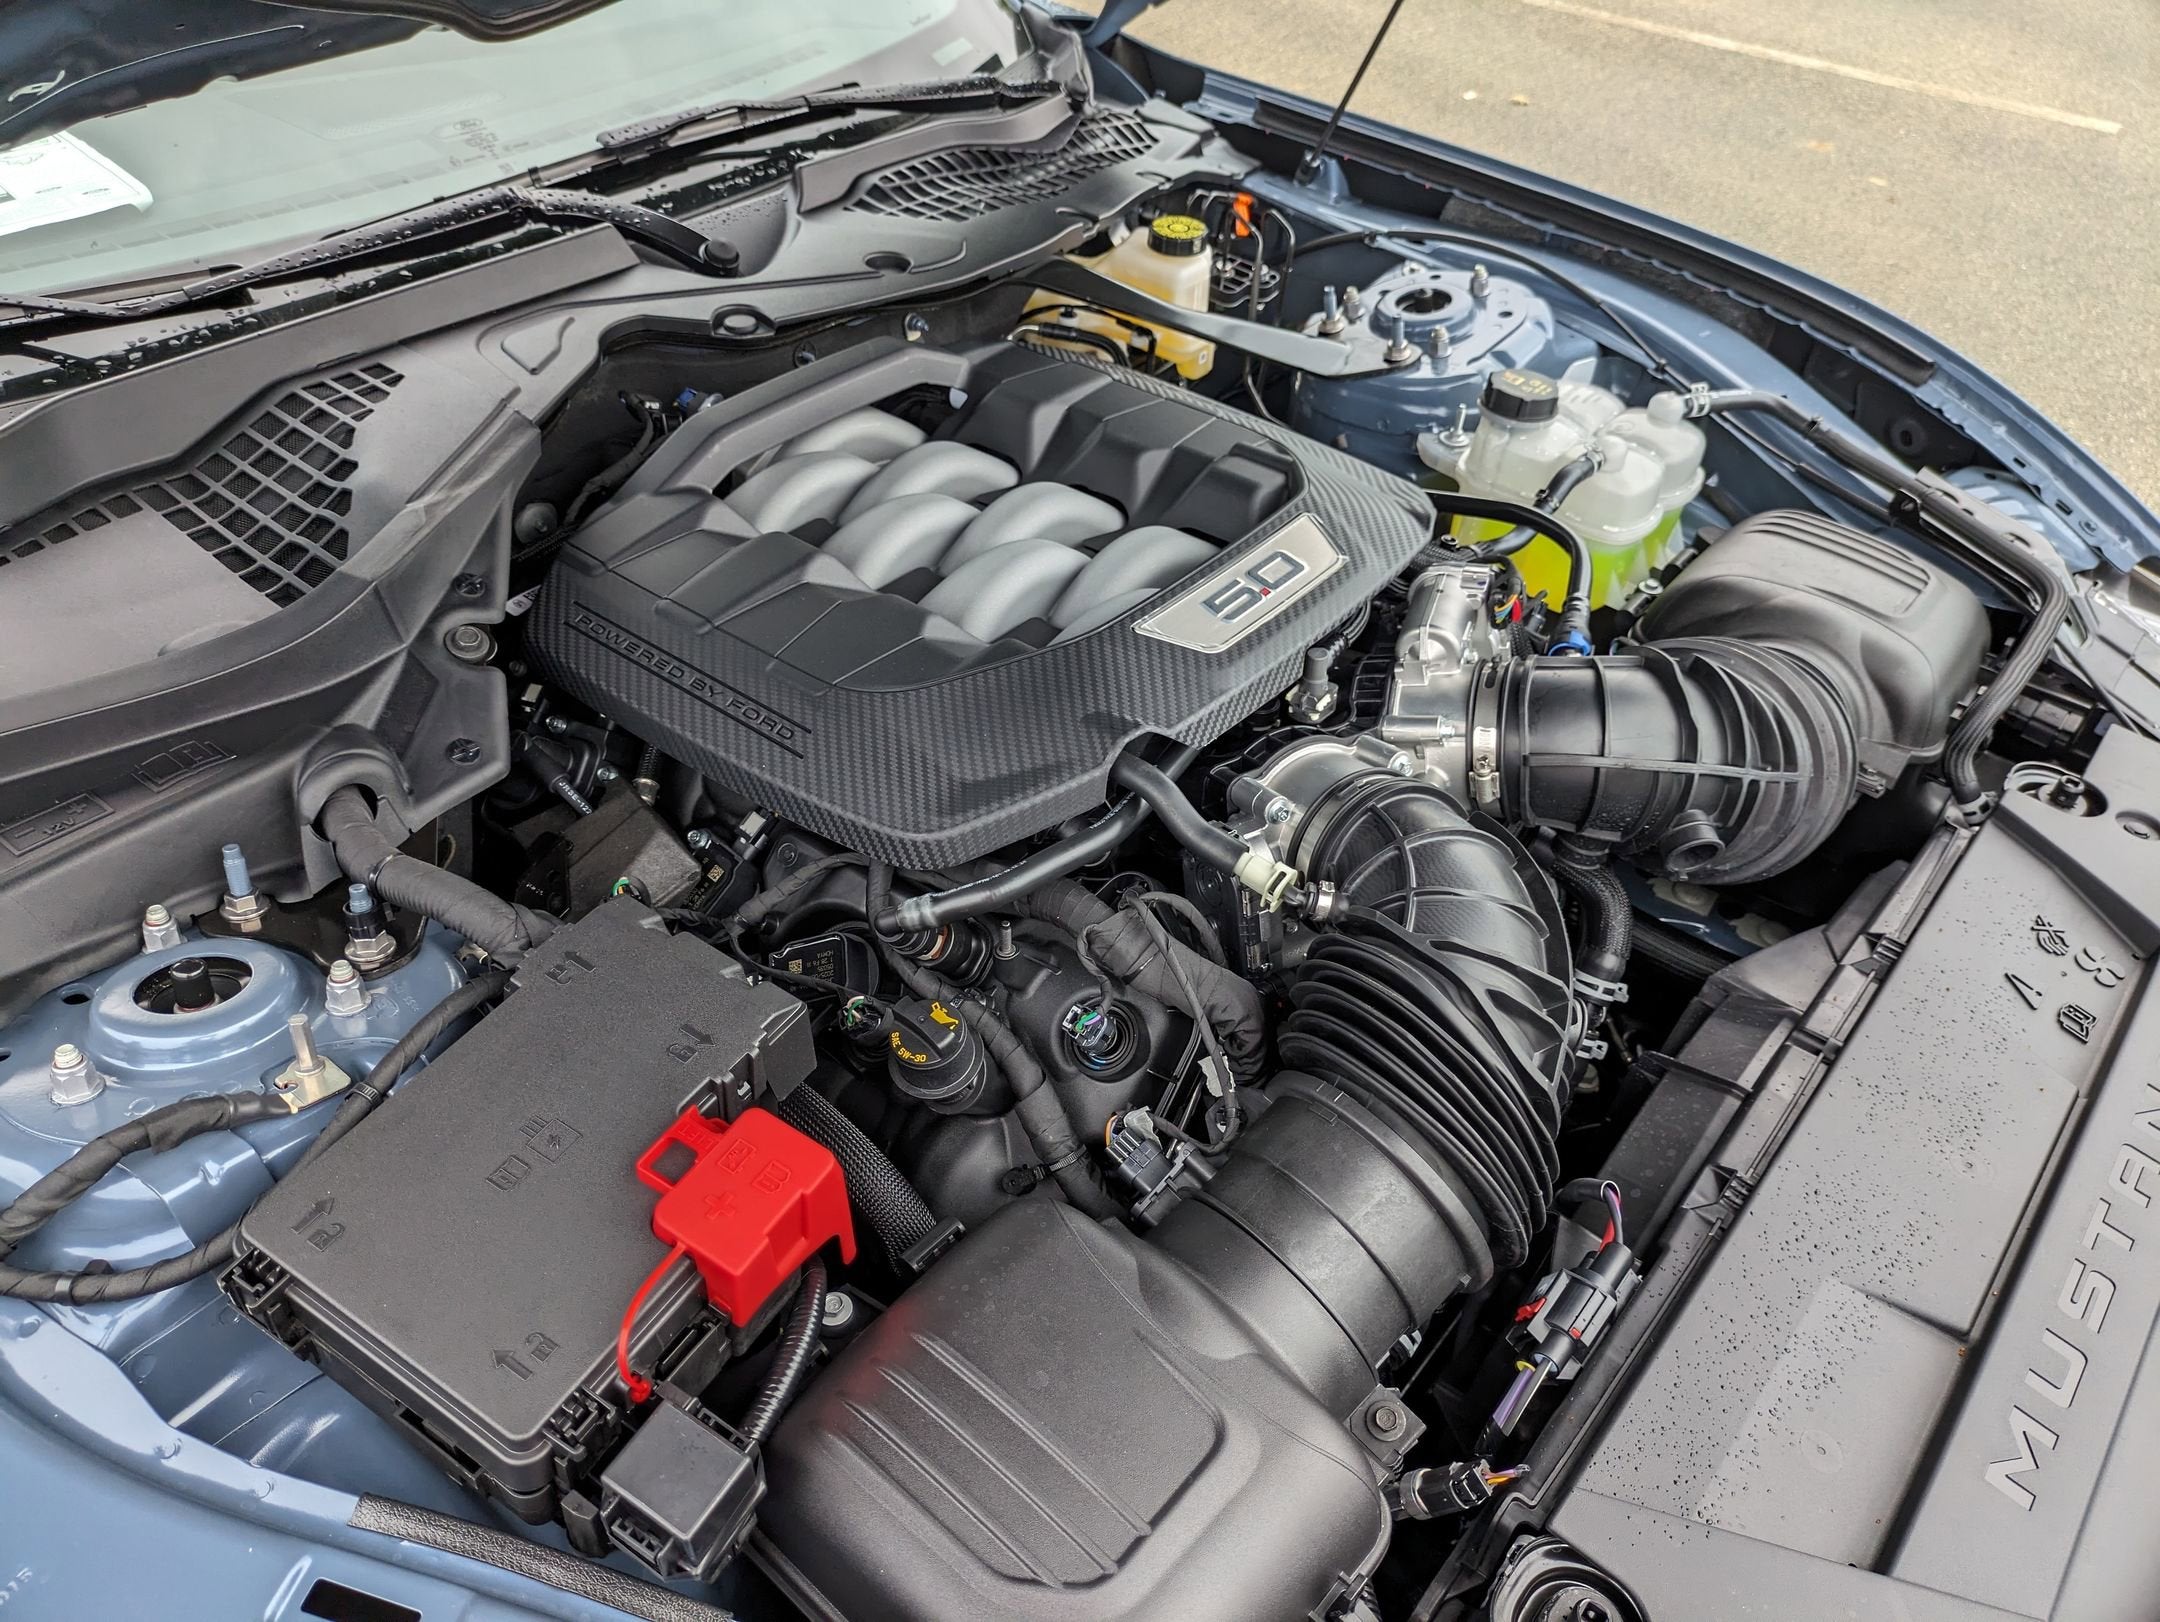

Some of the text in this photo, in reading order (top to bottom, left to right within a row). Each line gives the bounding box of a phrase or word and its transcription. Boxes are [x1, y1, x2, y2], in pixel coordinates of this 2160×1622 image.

[1201, 549, 1309, 624] 5.0
[575, 614, 795, 741] POWERED BY FORD
[43, 817, 75, 835] 12V
[891, 1032, 927, 1062] SAE 5W-30
